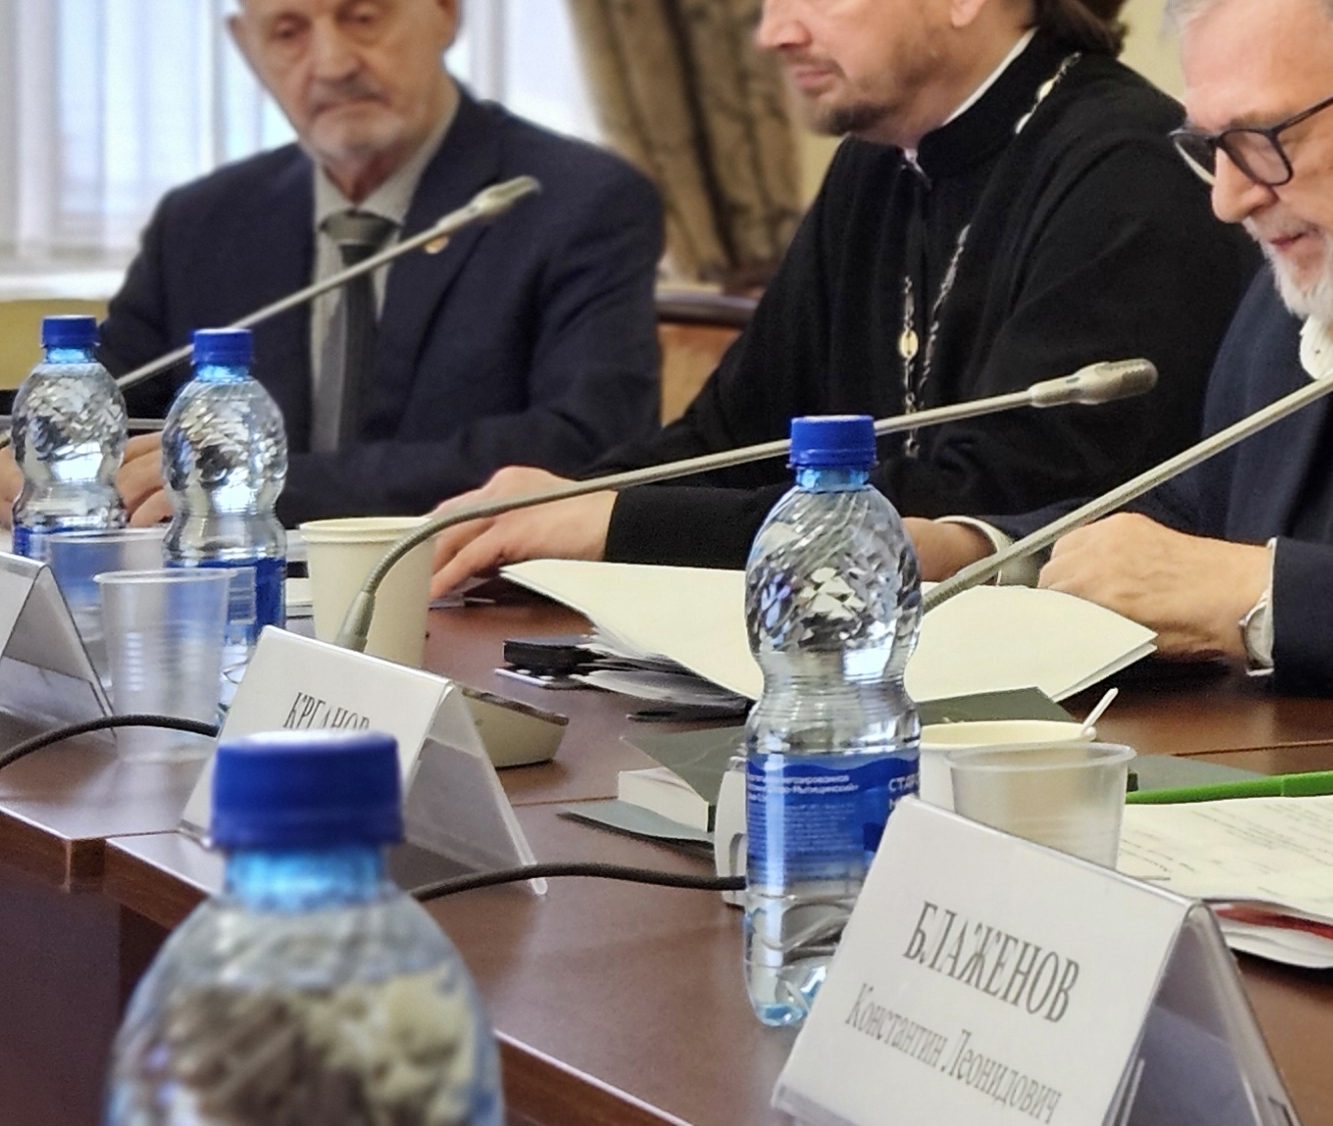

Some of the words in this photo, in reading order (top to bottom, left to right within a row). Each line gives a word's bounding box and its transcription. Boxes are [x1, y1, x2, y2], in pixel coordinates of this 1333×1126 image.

[902, 900, 1080, 1023] БЛАЖЕНОВ
[844, 982, 949, 1068] Константин
[939, 1028, 1063, 1125] Леонидович
